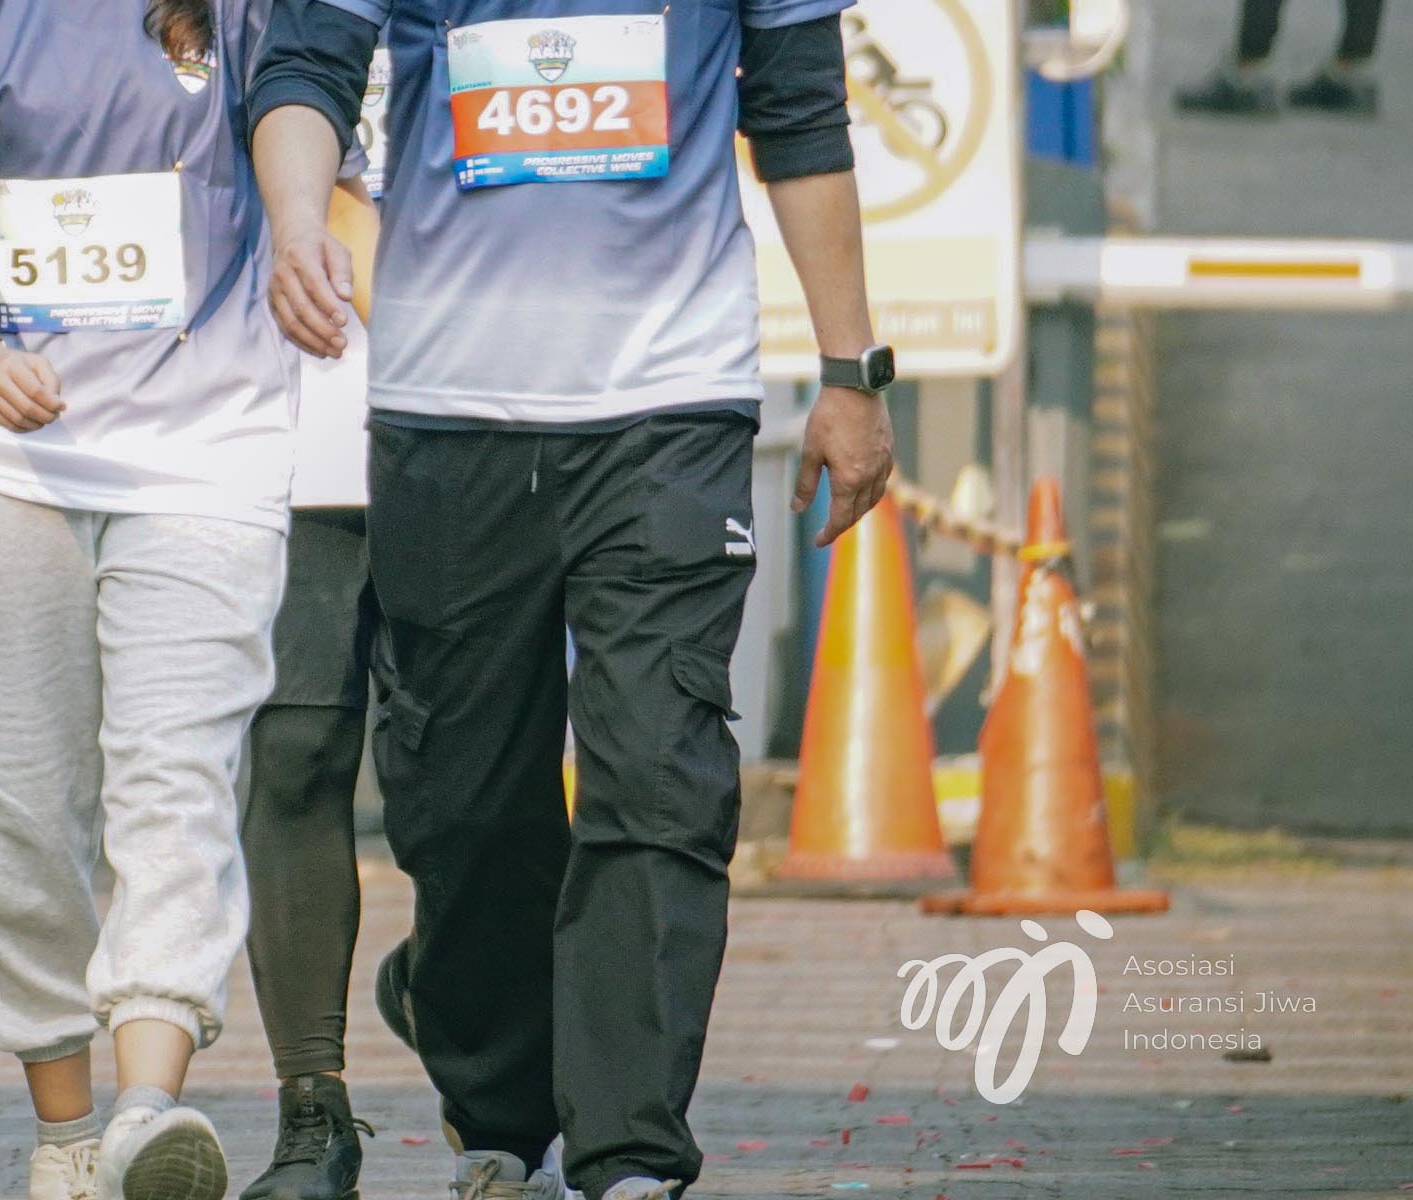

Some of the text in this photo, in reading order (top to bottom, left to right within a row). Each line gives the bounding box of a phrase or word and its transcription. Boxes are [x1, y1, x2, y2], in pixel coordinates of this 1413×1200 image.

[477, 86, 630, 136] 4692
[523, 152, 654, 166] PROGRESSIVE MOVES
[536, 162, 642, 176] COLLECTIVE WINS
[10, 243, 147, 286] 5139
